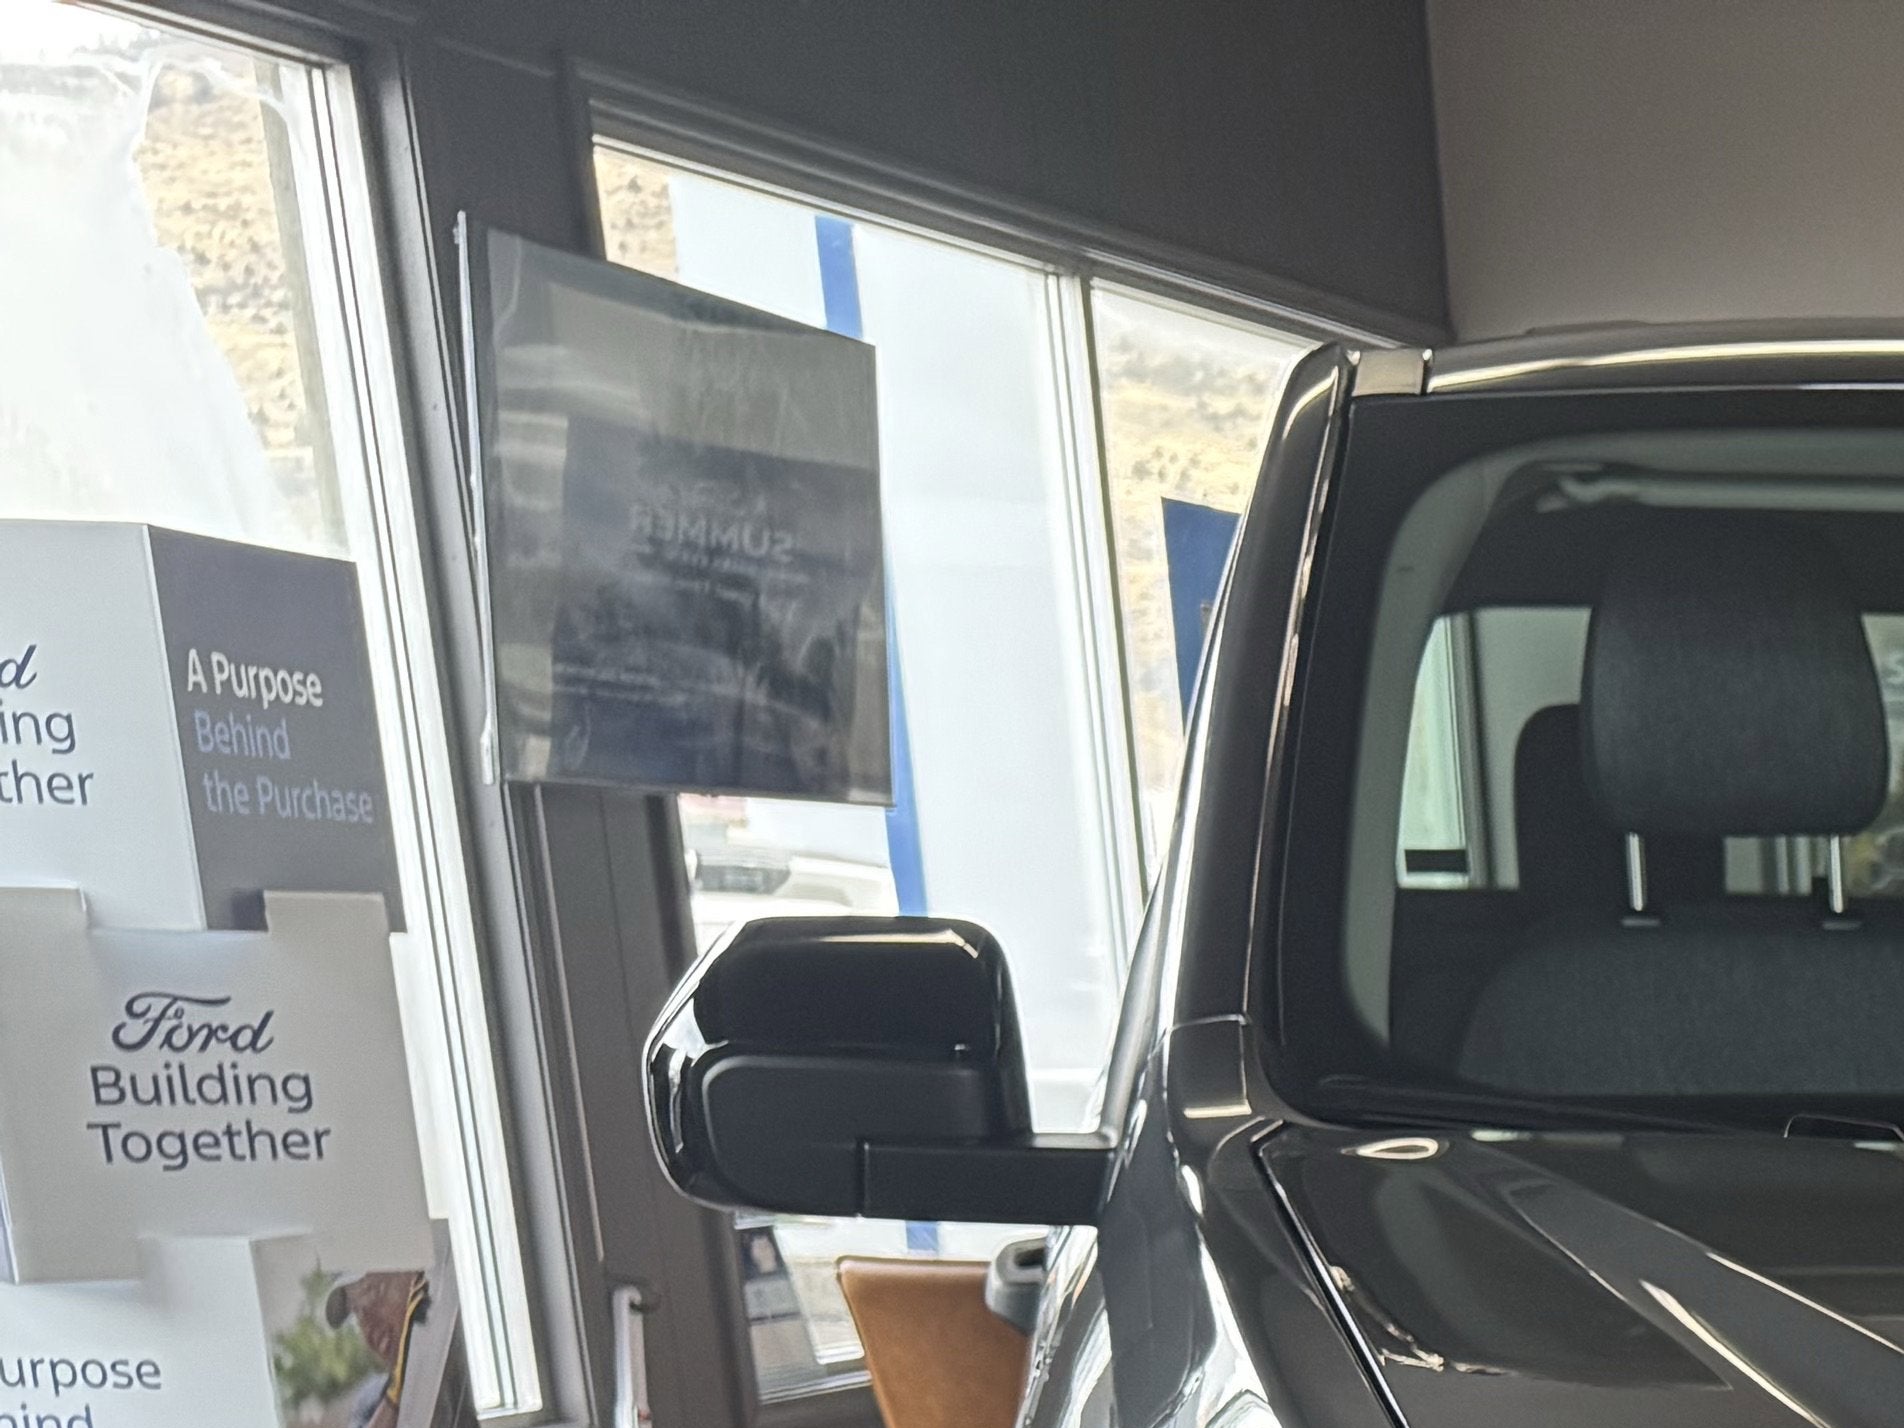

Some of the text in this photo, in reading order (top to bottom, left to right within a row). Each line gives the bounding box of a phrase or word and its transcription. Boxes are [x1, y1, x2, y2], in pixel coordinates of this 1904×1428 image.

[186, 648, 323, 710] A Purpose
[194, 709, 292, 760] Behind
[202, 770, 374, 825] the Purchase
[111, 991, 274, 1054] Ford
[90, 1060, 314, 1114] Building
[86, 1118, 331, 1172] Together
[0, 1357, 162, 1397] urpose
